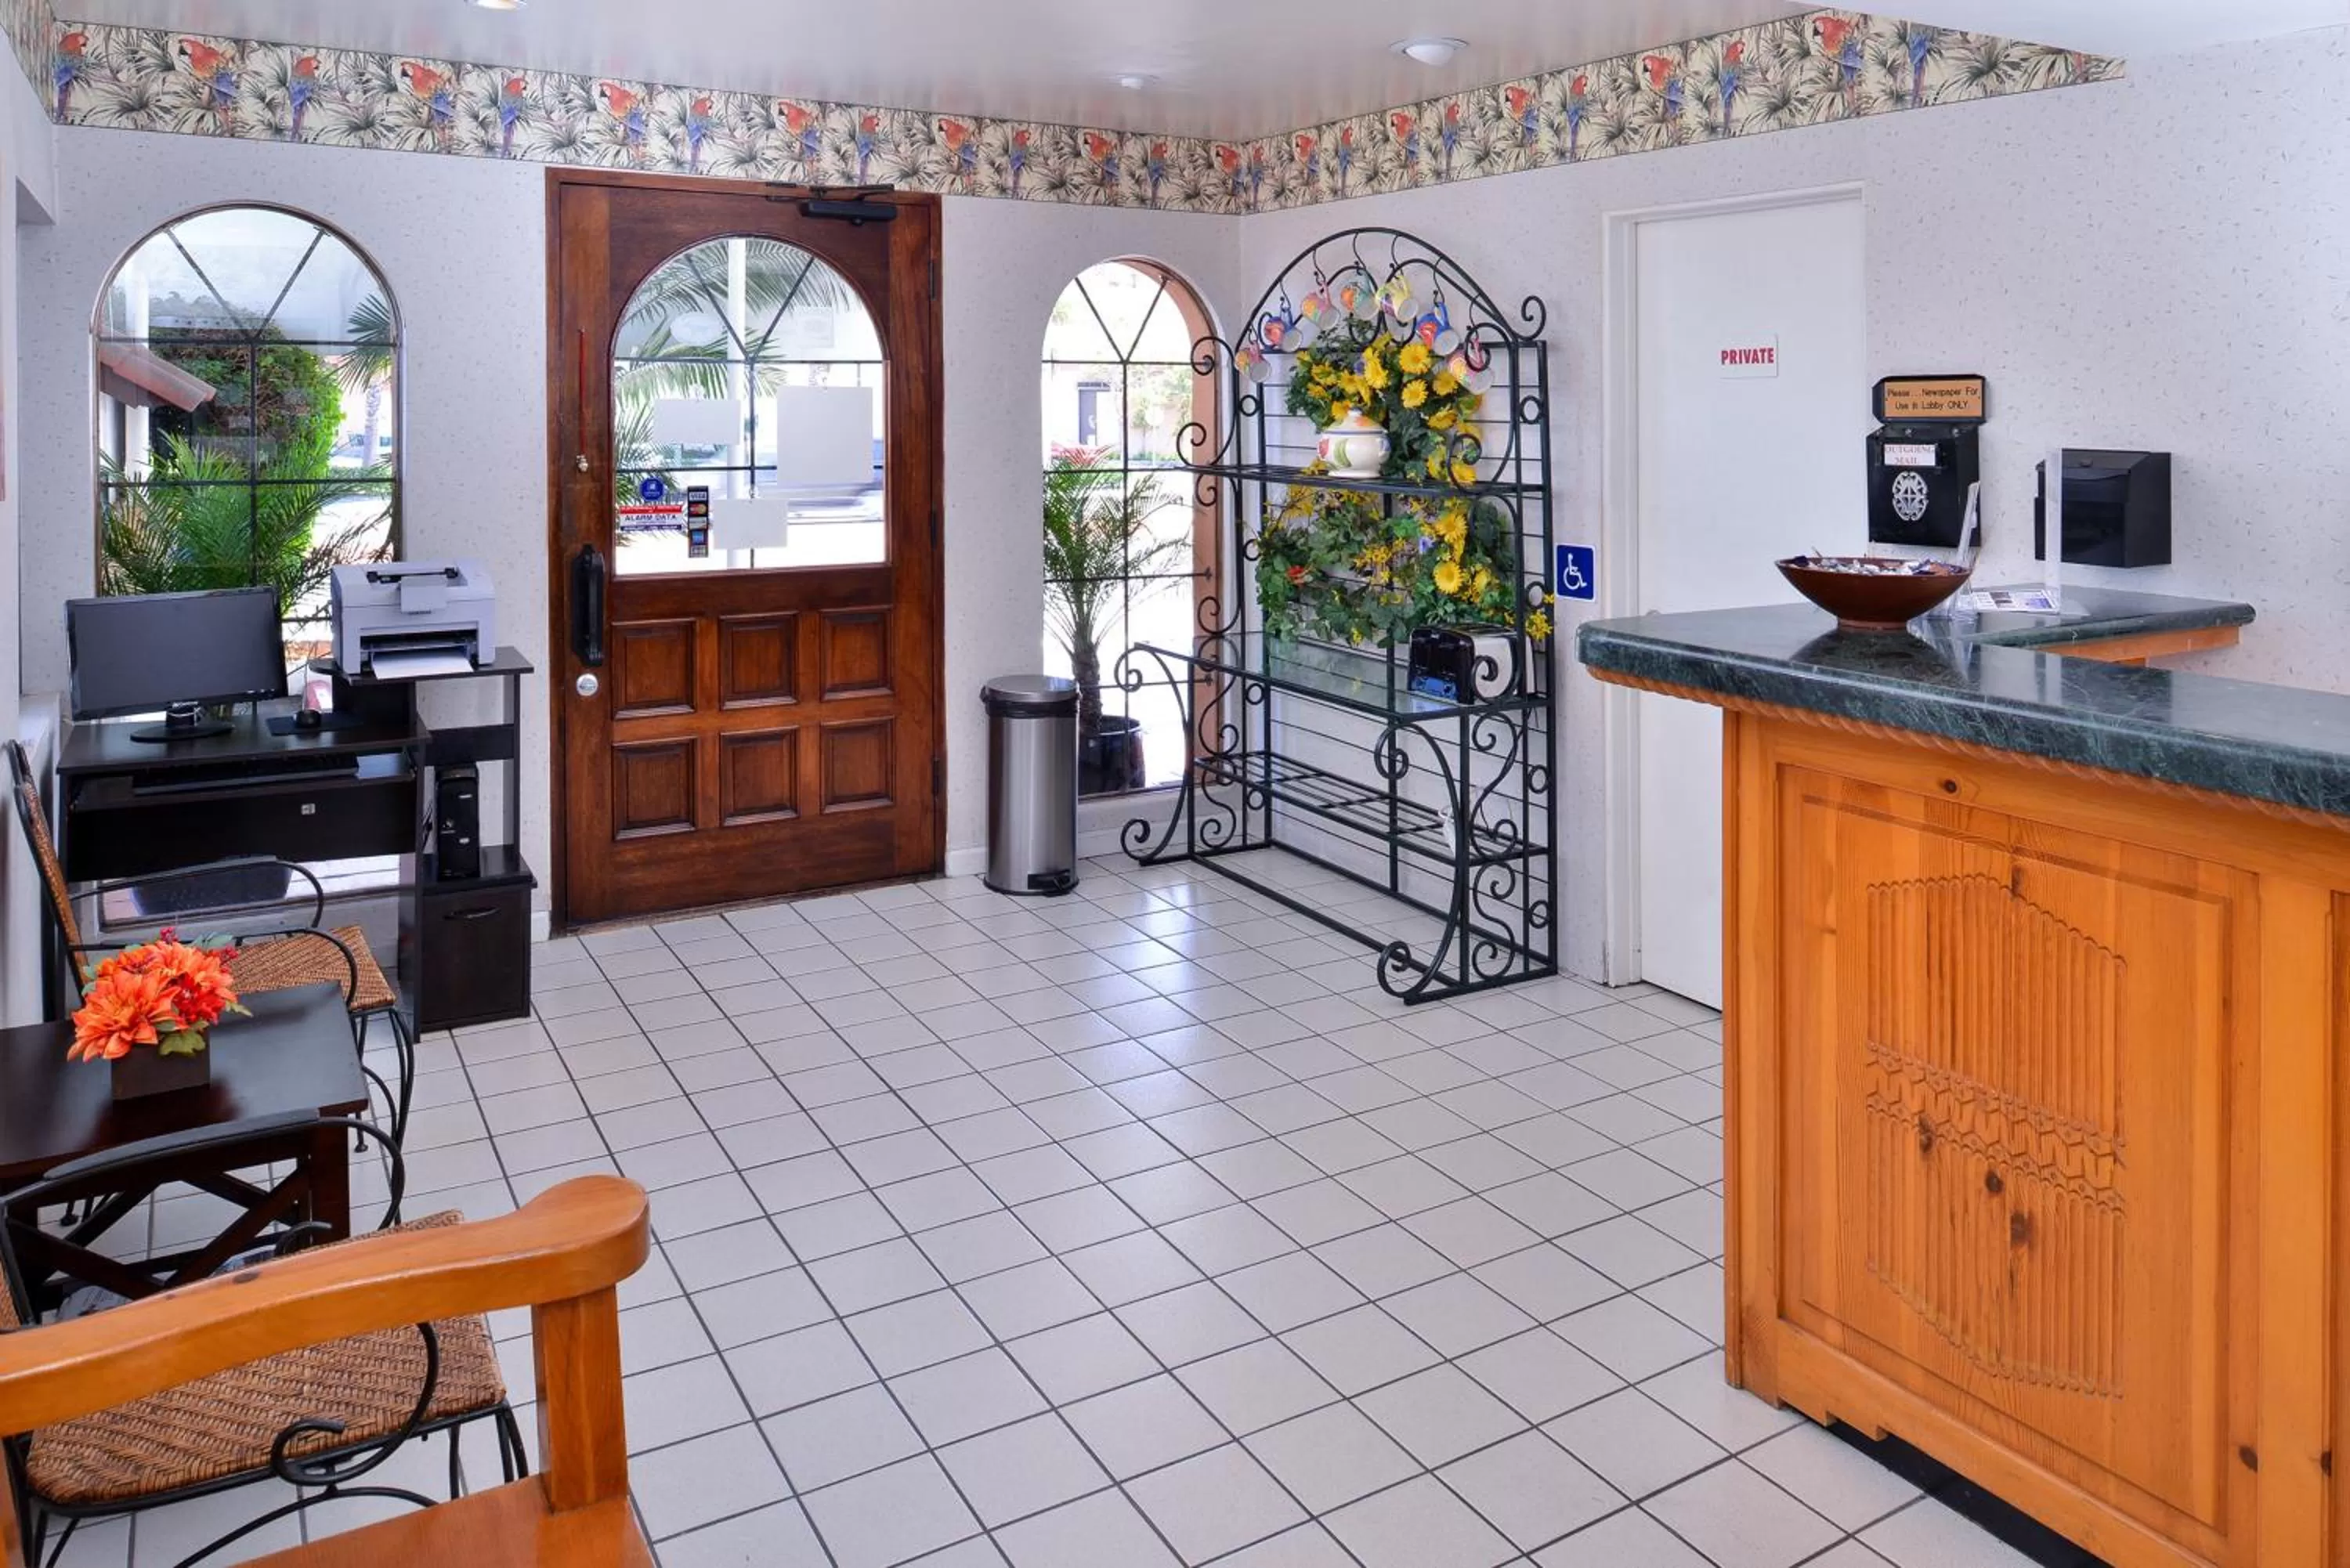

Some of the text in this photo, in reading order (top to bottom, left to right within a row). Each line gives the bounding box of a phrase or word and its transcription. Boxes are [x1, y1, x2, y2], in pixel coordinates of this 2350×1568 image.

[1721, 348, 1774, 365] PRIVATE
[1965, 387, 1979, 396] For
[1895, 400, 1909, 410] Use
[1922, 400, 1943, 410] Lobby
